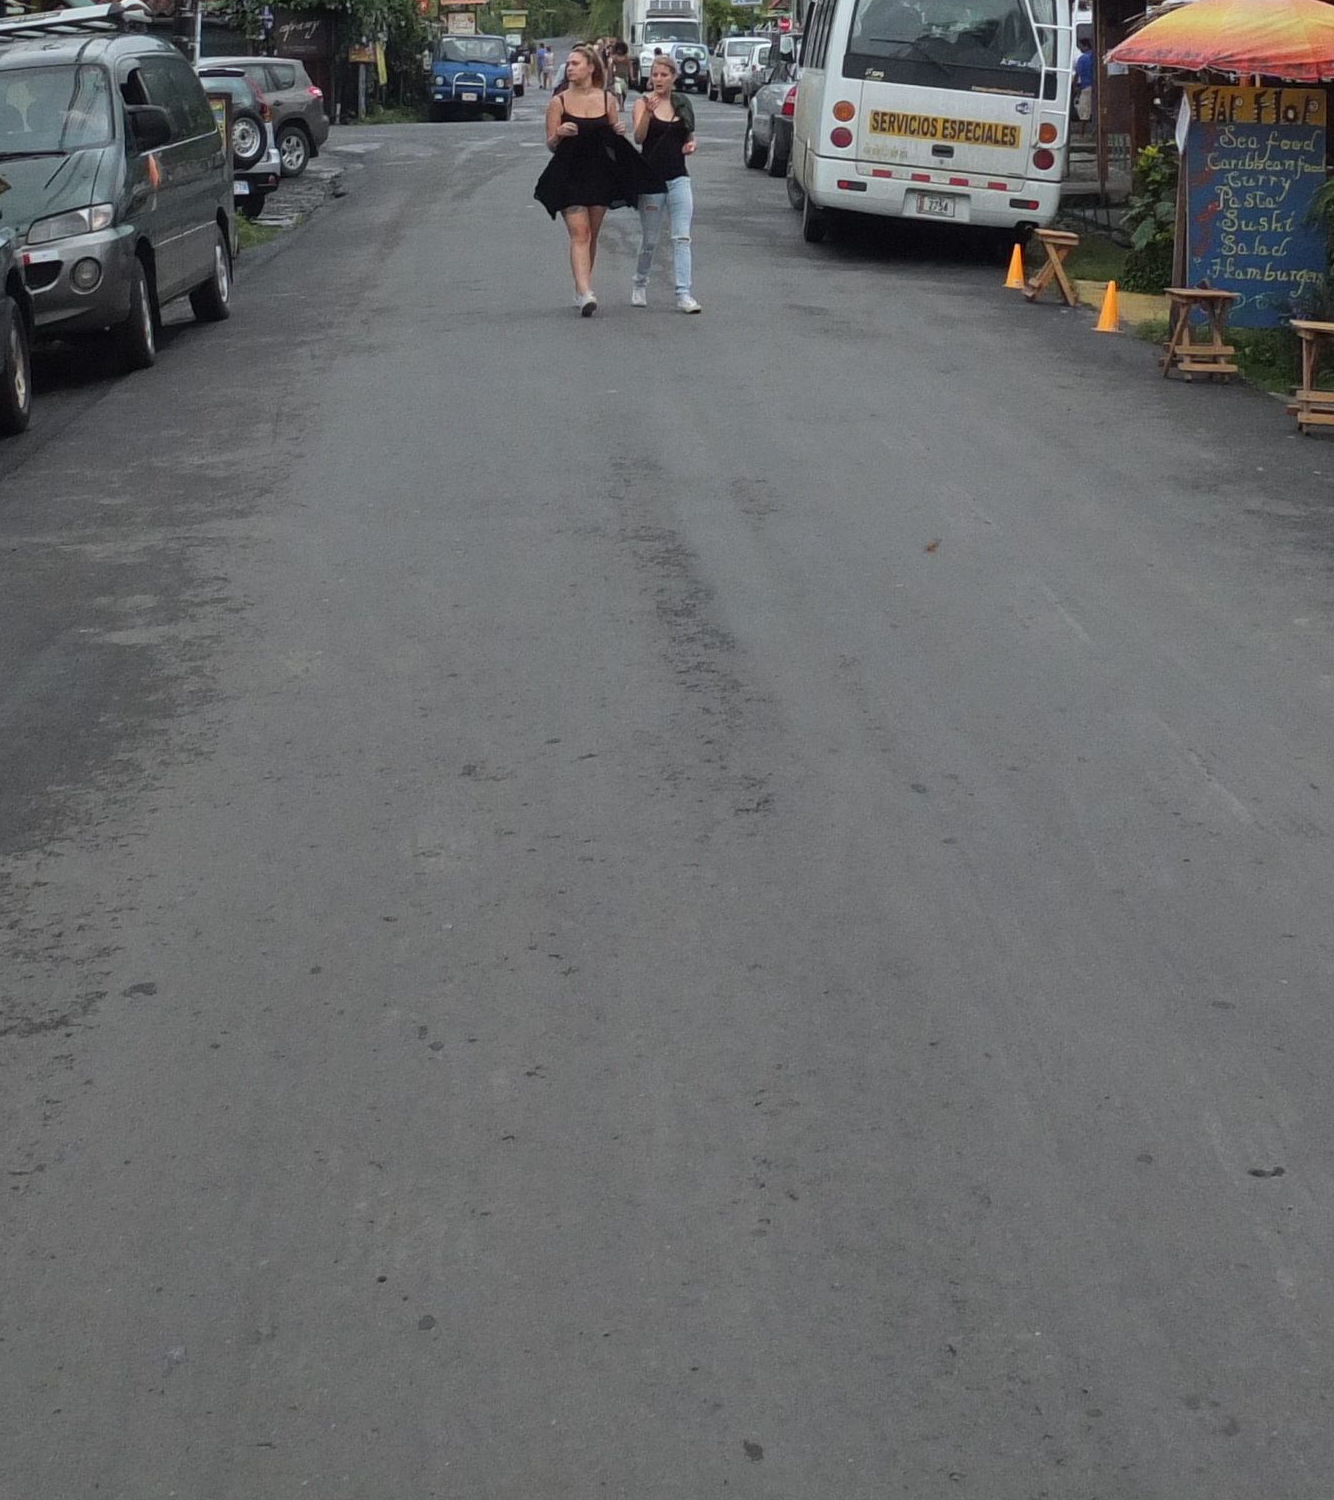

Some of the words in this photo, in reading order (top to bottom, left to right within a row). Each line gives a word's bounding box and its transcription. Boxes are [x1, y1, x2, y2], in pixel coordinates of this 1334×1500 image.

[871, 111, 938, 138] SERVICIOS
[941, 119, 1018, 147] ESPECIALES
[1215, 185, 1278, 211] Pasta
[1225, 171, 1291, 201] Curry
[1217, 208, 1296, 232] Sushi
[1218, 233, 1293, 257] Salad
[1208, 257, 1325, 298] Hamburgers
